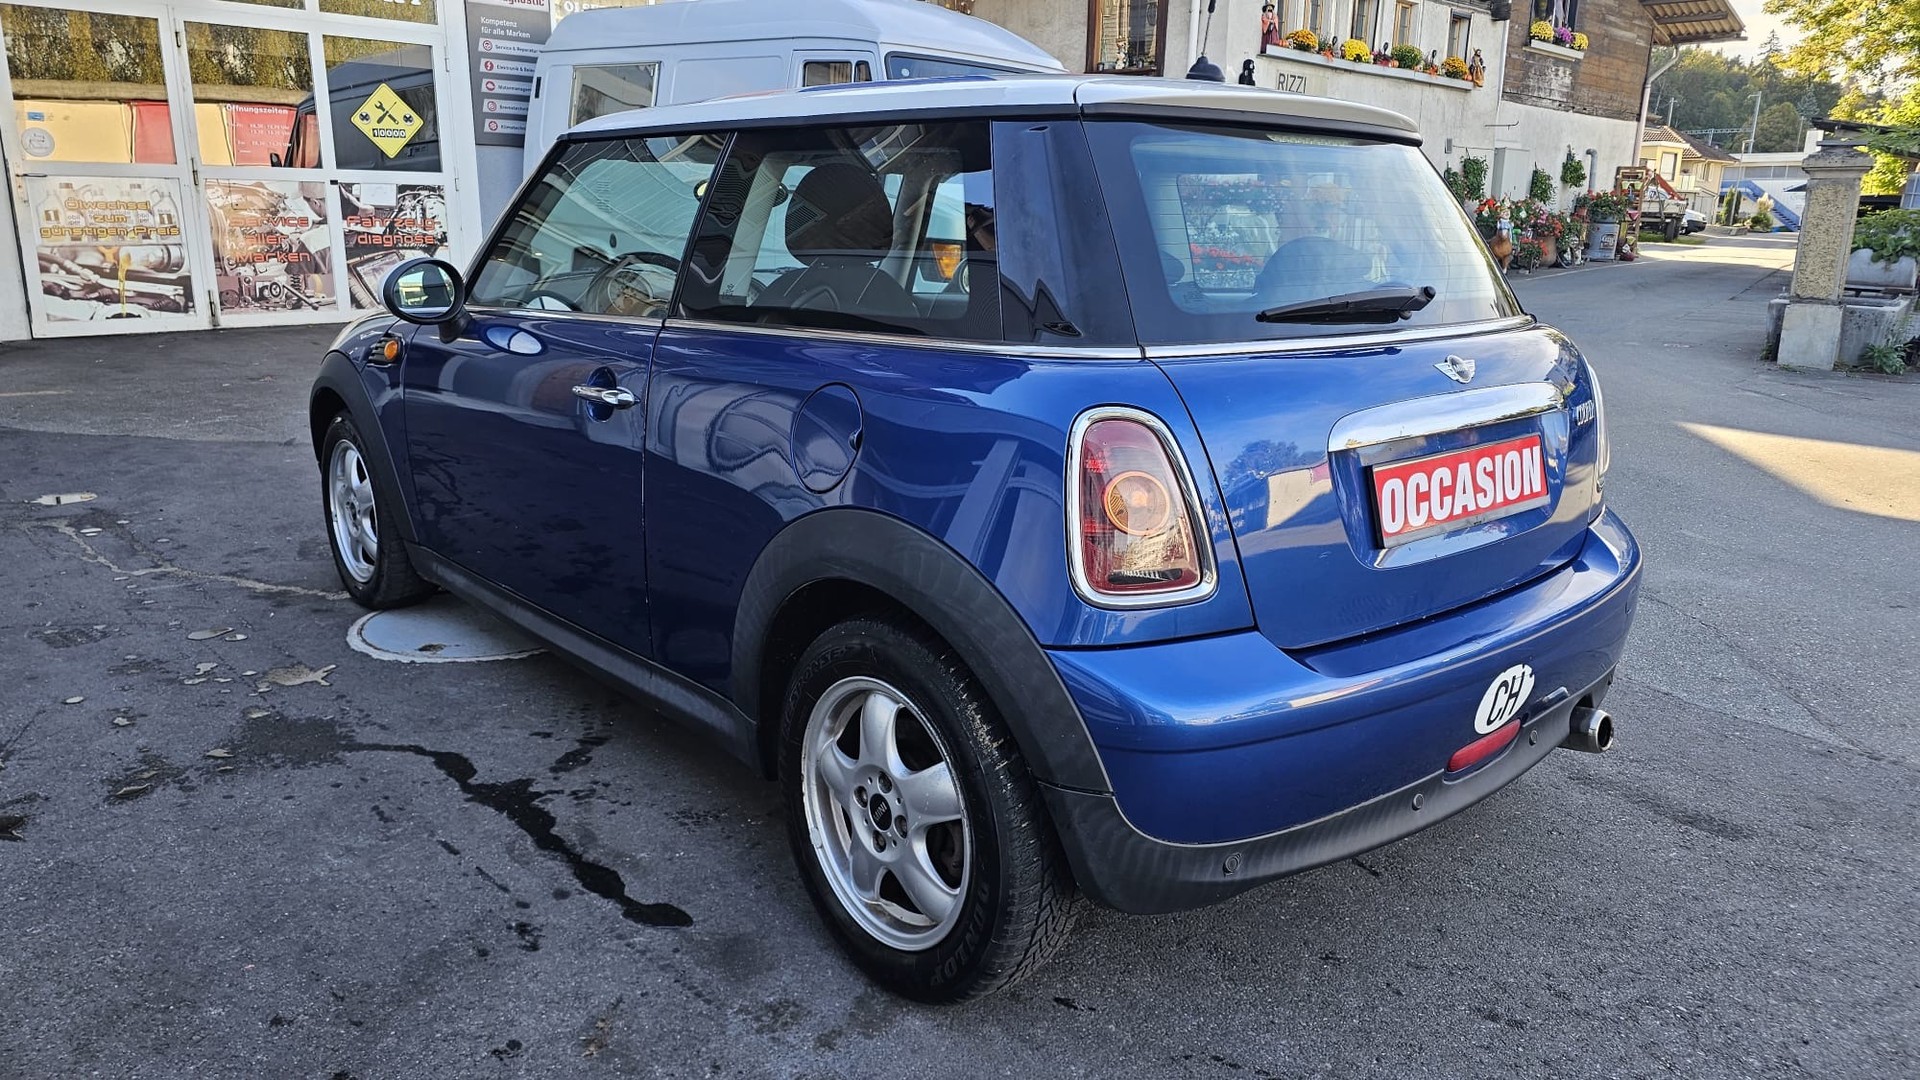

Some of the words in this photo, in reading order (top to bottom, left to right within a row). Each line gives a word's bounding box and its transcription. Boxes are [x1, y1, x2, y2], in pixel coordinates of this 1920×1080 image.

[480, 16, 518, 28] Kompetenz
[481, 26, 491, 34] für
[493, 28, 505, 36] alle
[506, 29, 531, 38] Marken
[1277, 72, 1307, 94] RIZZI
[226, 103, 289, 115] Öffnungszeiten
[372, 128, 406, 138] 10000
[64, 197, 152, 211] Ölwechsel
[92, 213, 128, 223] zum
[229, 216, 309, 228] Service
[40, 225, 129, 239] günstigen
[132, 226, 180, 236] Preis
[245, 233, 289, 246] aller
[357, 232, 435, 248] diagnose
[234, 251, 311, 263] Marken
[1381, 445, 1543, 534] OCCASION
[1486, 670, 1526, 727] CH
